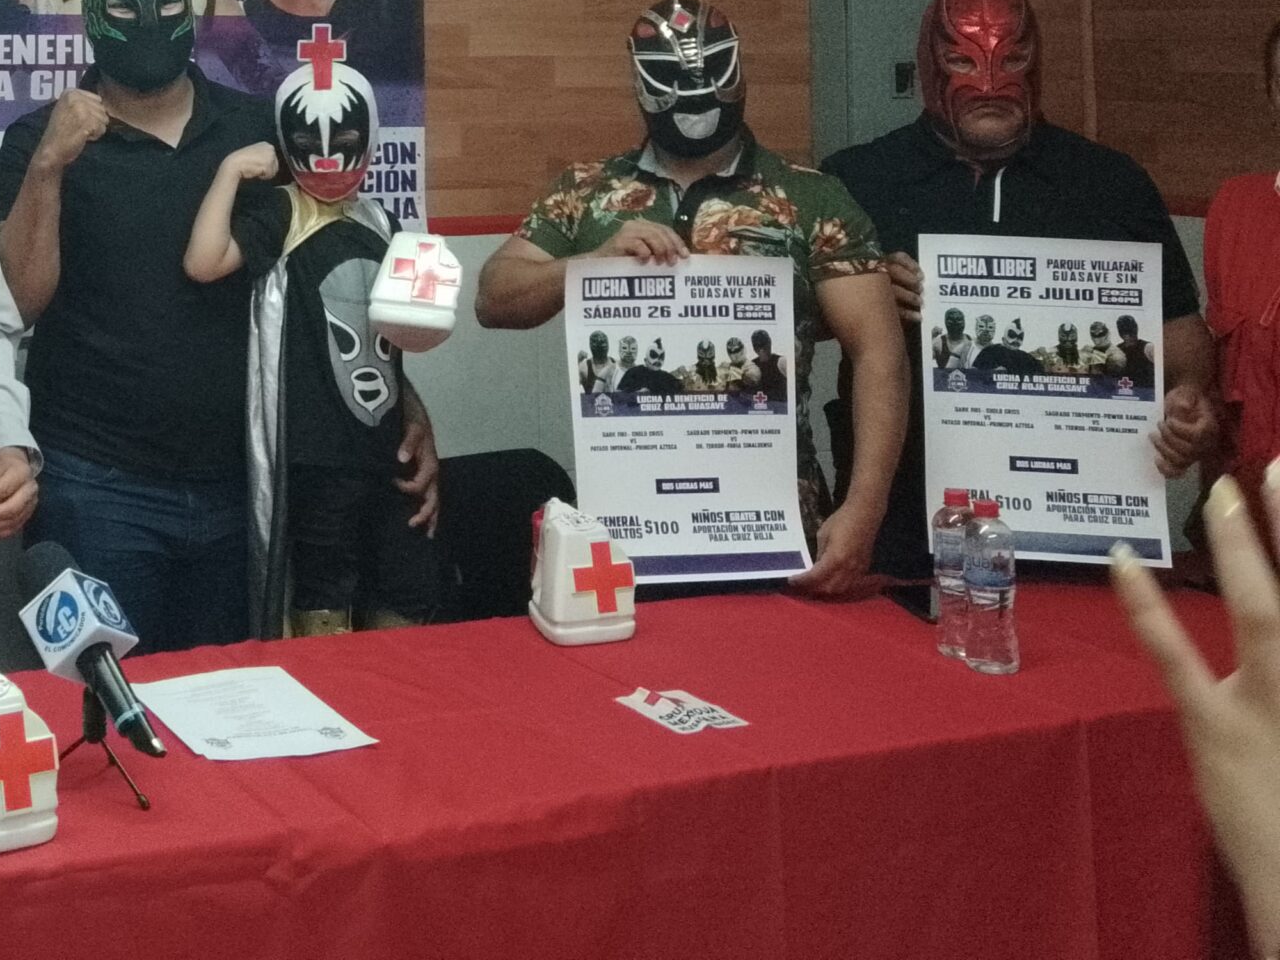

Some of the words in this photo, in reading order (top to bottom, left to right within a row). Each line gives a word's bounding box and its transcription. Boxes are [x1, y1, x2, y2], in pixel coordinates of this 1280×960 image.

[939, 257, 987, 277] LUCHA
[993, 258, 1034, 277] LIBRE
[1047, 259, 1085, 271] PARQUE
[1091, 259, 1144, 273] VILLAFAÑE
[685, 276, 721, 287] PARQUE
[726, 274, 776, 286] VILLAFAÑE
[1053, 271, 1109, 283] GUASAVE
[1117, 273, 1137, 283] SIN
[585, 279, 628, 297] LUCHA
[634, 278, 673, 296] LIBRE
[691, 289, 743, 299] GUASAVE
[750, 289, 770, 298] SIN
[939, 283, 1000, 297] SÁBADO
[1007, 286, 1031, 299] 26
[1039, 288, 1093, 301] JULIO
[583, 305, 641, 319] SÁBADO
[648, 306, 671, 318] 26
[678, 305, 729, 317] JULIO
[1046, 489, 1080, 504] NIÑOS
[1126, 496, 1148, 507] CON
[692, 509, 723, 523] NIÑOS
[764, 510, 785, 522] CON
[645, 519, 679, 534] $100
